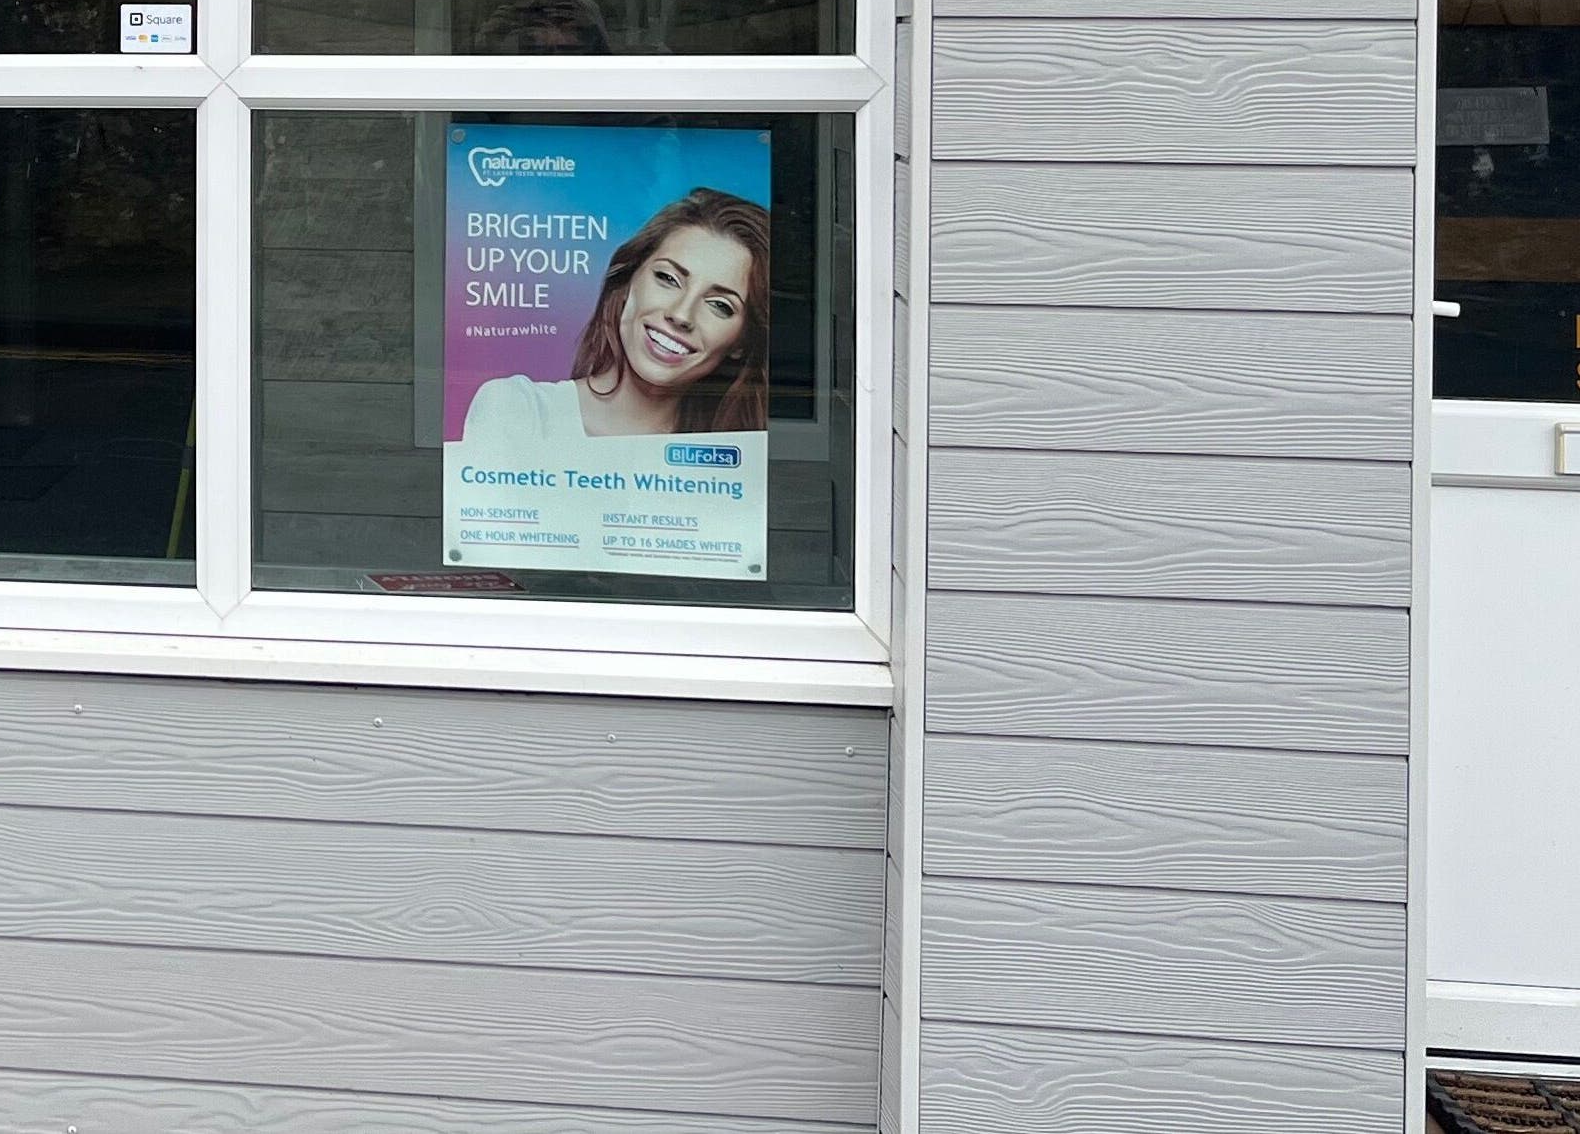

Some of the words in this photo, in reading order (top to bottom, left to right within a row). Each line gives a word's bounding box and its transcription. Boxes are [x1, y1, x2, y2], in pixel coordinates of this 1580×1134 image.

[146, 15, 183, 26] Square
[482, 156, 576, 172] naturawhite
[466, 212, 608, 242] BRIGHTEN
[466, 247, 505, 274] UP
[508, 248, 590, 276] YOUR
[465, 280, 550, 309] SMILE
[465, 323, 558, 338] #Naturawhite
[460, 465, 557, 488] Cosmetic
[562, 469, 627, 491] Teeth
[632, 473, 744, 500] Whitening
[460, 507, 539, 521] NON-SENSITIVE
[602, 513, 648, 527] INSTANT
[651, 514, 699, 528] RESULTS
[460, 530, 483, 542] ONE
[485, 530, 516, 542] HOUR
[518, 531, 580, 545] WHITENING
[602, 535, 618, 548] UP
[620, 536, 636, 548] TO
[639, 536, 653, 548] 16
[654, 537, 697, 551] SHADES
[699, 539, 743, 553] WHITER
